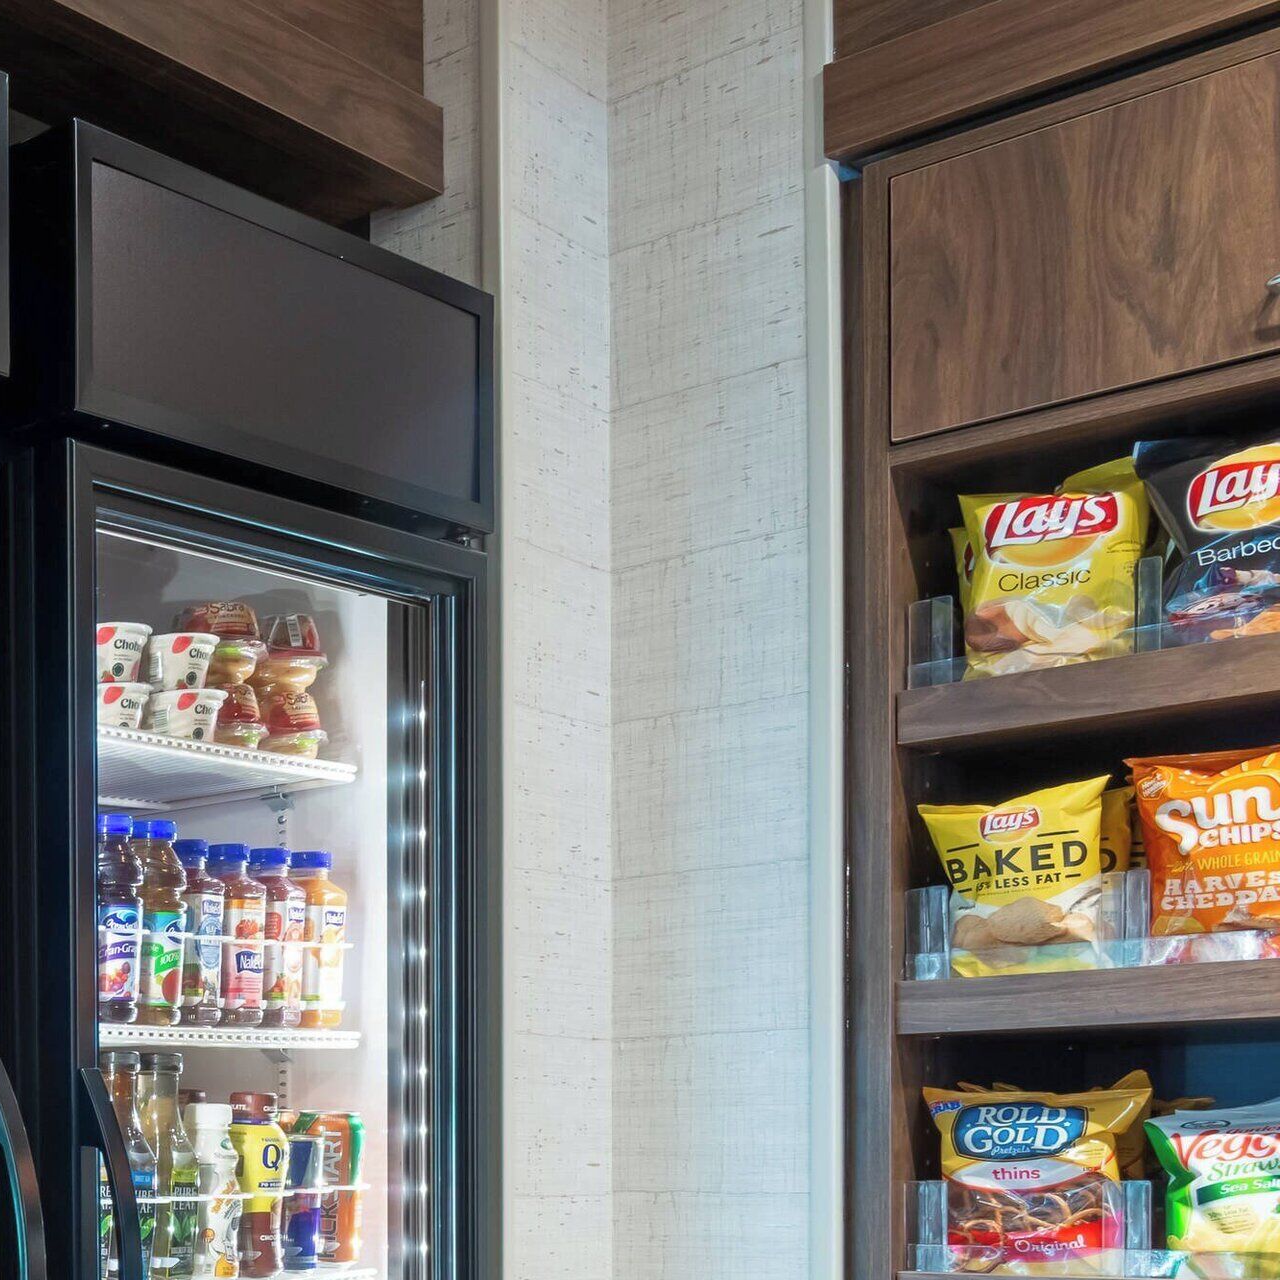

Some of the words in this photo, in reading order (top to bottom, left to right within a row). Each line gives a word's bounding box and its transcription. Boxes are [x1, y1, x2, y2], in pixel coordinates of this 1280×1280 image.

[1196, 462, 1280, 518] Lay
[998, 567, 1091, 592] Classic
[208, 602, 245, 614] Sabra
[1155, 787, 1280, 856] Sun
[945, 840, 1088, 885] BAKED
[1197, 855, 1242, 871] WHOLE
[995, 877, 1029, 890] LESS
[1036, 872, 1062, 885] FAT
[976, 1106, 1067, 1126] ROLD
[963, 1124, 1068, 1154] GOLD
[991, 1145, 1031, 1156] Pretzels
[992, 1166, 1041, 1181] thins
[1220, 1183, 1248, 1195] Sea
[1015, 1234, 1087, 1256] Original
